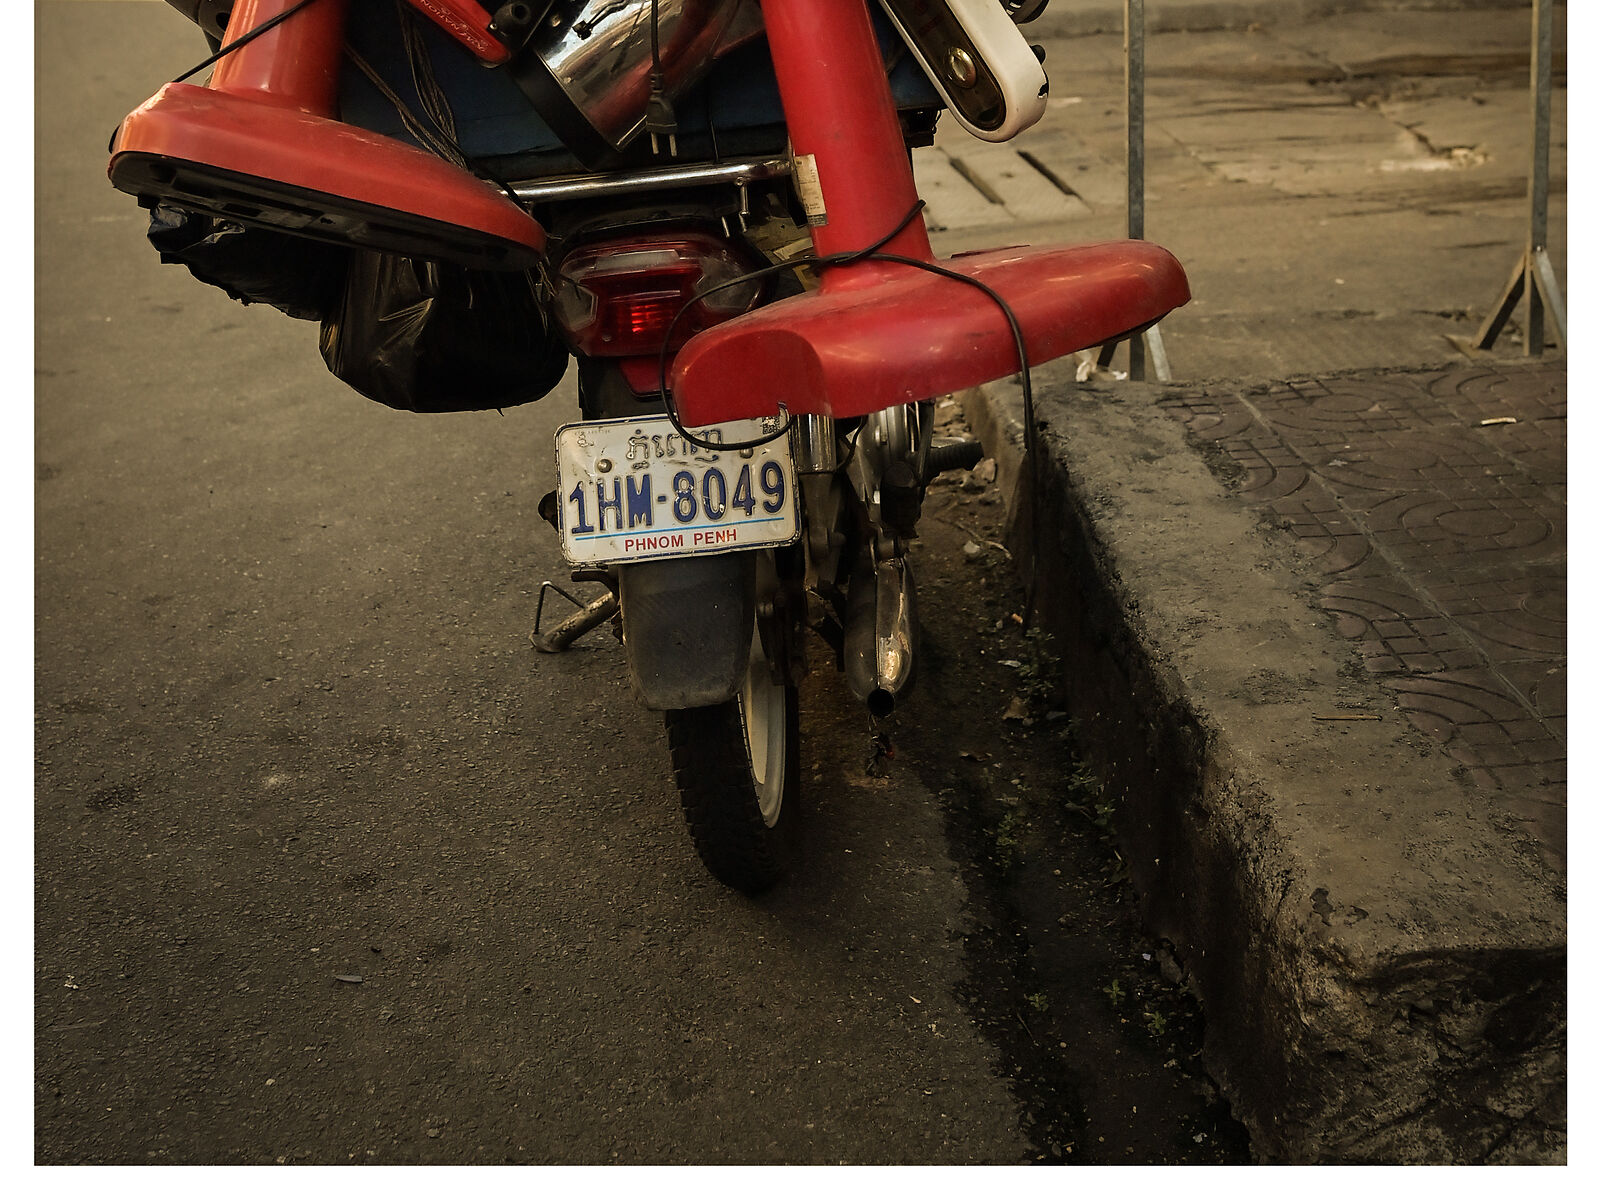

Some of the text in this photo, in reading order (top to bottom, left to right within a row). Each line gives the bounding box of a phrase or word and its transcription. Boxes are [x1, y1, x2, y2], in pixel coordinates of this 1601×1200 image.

[569, 461, 785, 534] 1HM-8049
[625, 528, 737, 552] PHNOM PENH
